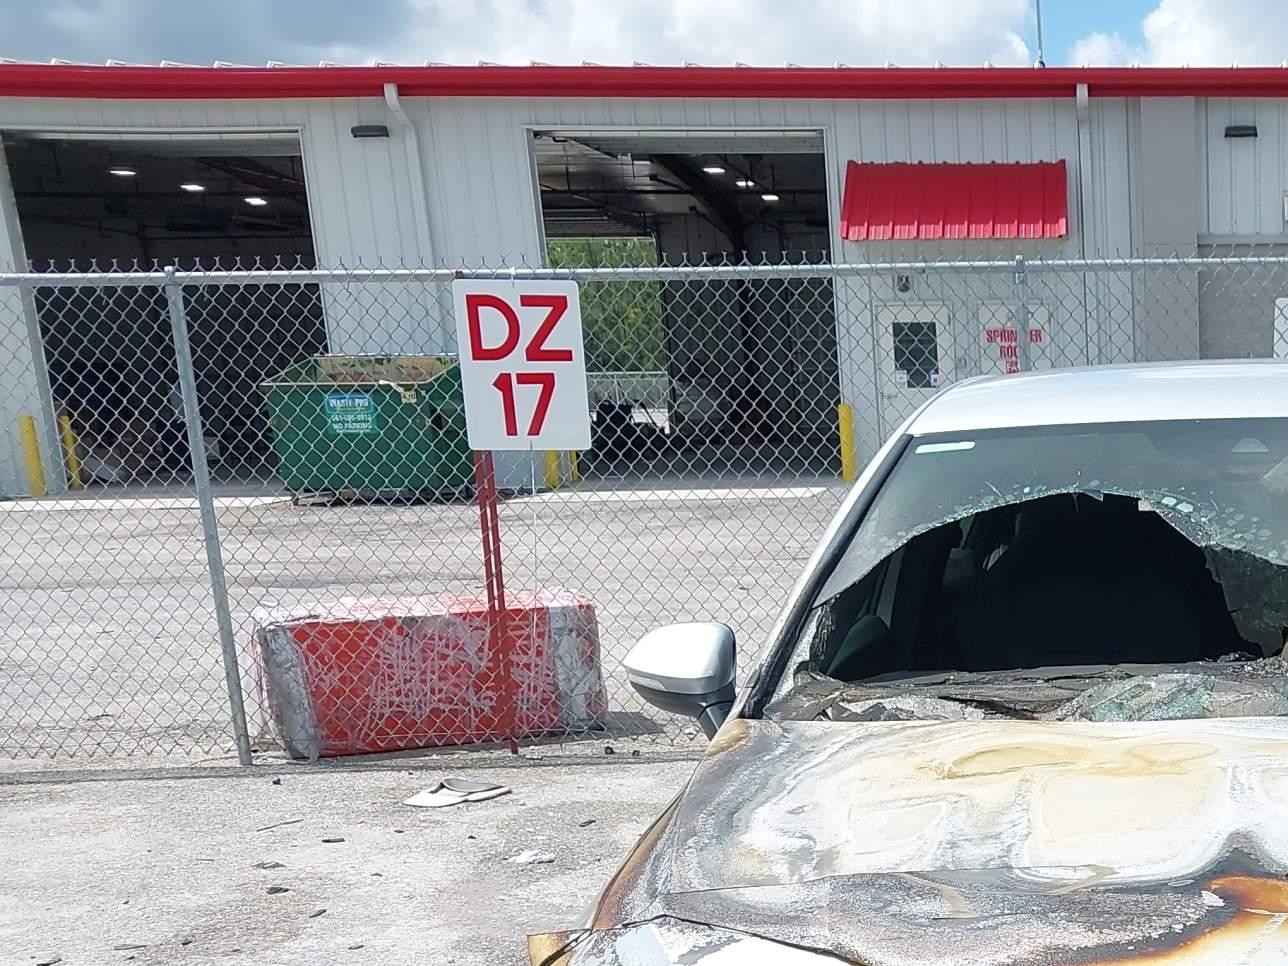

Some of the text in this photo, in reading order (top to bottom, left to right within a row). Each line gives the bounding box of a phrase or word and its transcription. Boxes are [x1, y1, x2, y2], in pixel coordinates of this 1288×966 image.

[465, 294, 574, 362] DZ
[986, 329, 1042, 343] SPRINER
[492, 372, 556, 436] 17
